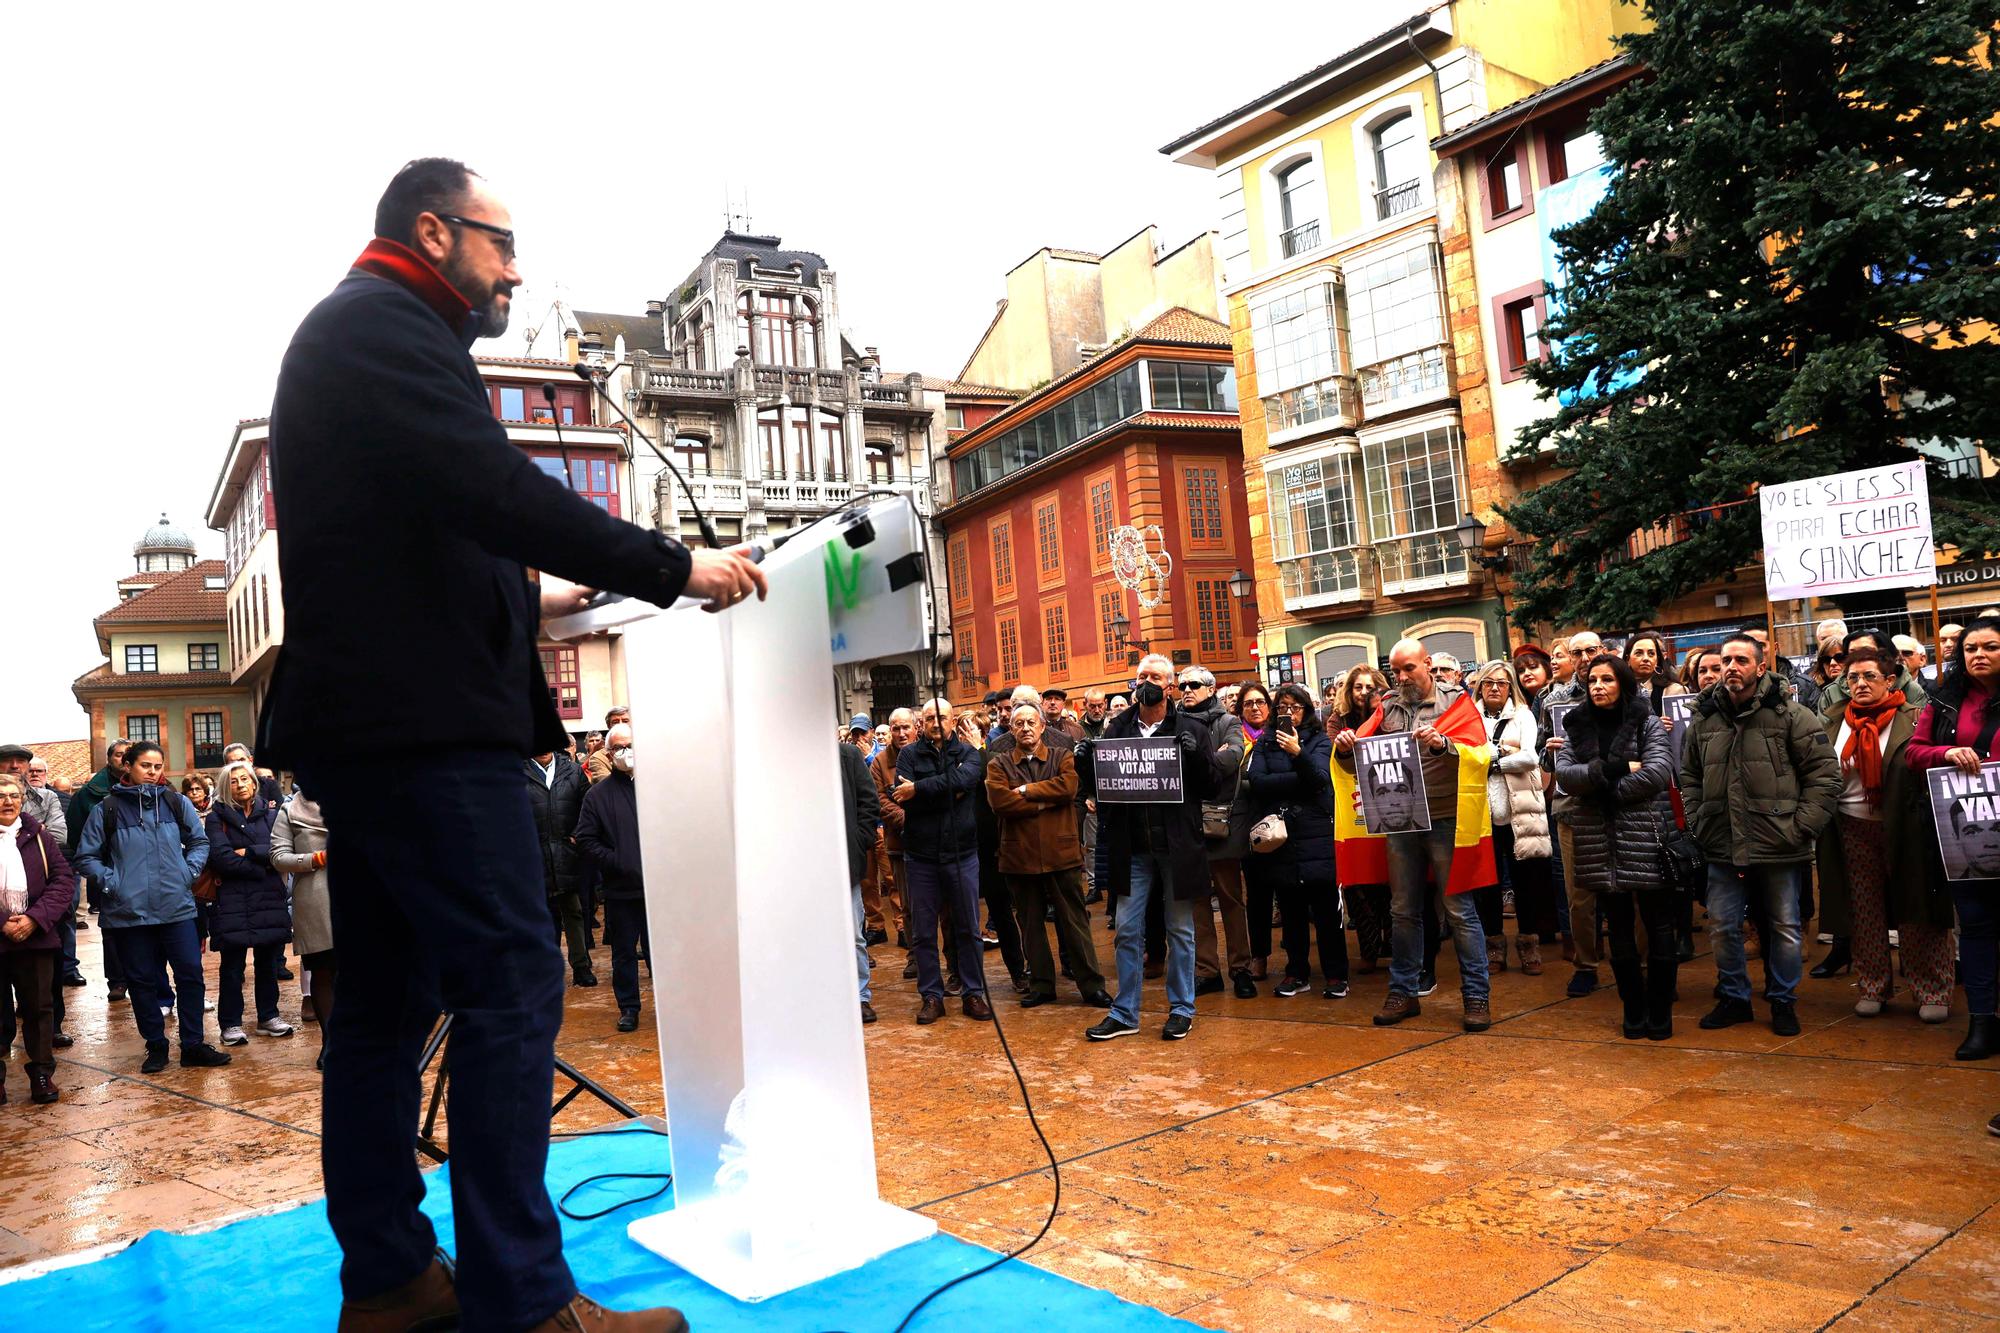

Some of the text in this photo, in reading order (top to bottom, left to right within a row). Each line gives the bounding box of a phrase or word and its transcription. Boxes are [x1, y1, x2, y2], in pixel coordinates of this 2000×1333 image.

[1763, 491, 1786, 511] YO
[1793, 488, 1812, 507] EL
[1857, 475, 1880, 500] ES
[1776, 502, 1919, 543] PARA ECHAR
[1768, 536, 1931, 585] A SANCHEZ
[1141, 748, 1177, 762] QUIERE
[1361, 737, 1411, 765] ¡VETE
[1119, 761, 1156, 774] VOTAR!
[1373, 762, 1404, 784] YA!
[1161, 778, 1180, 790] YA!
